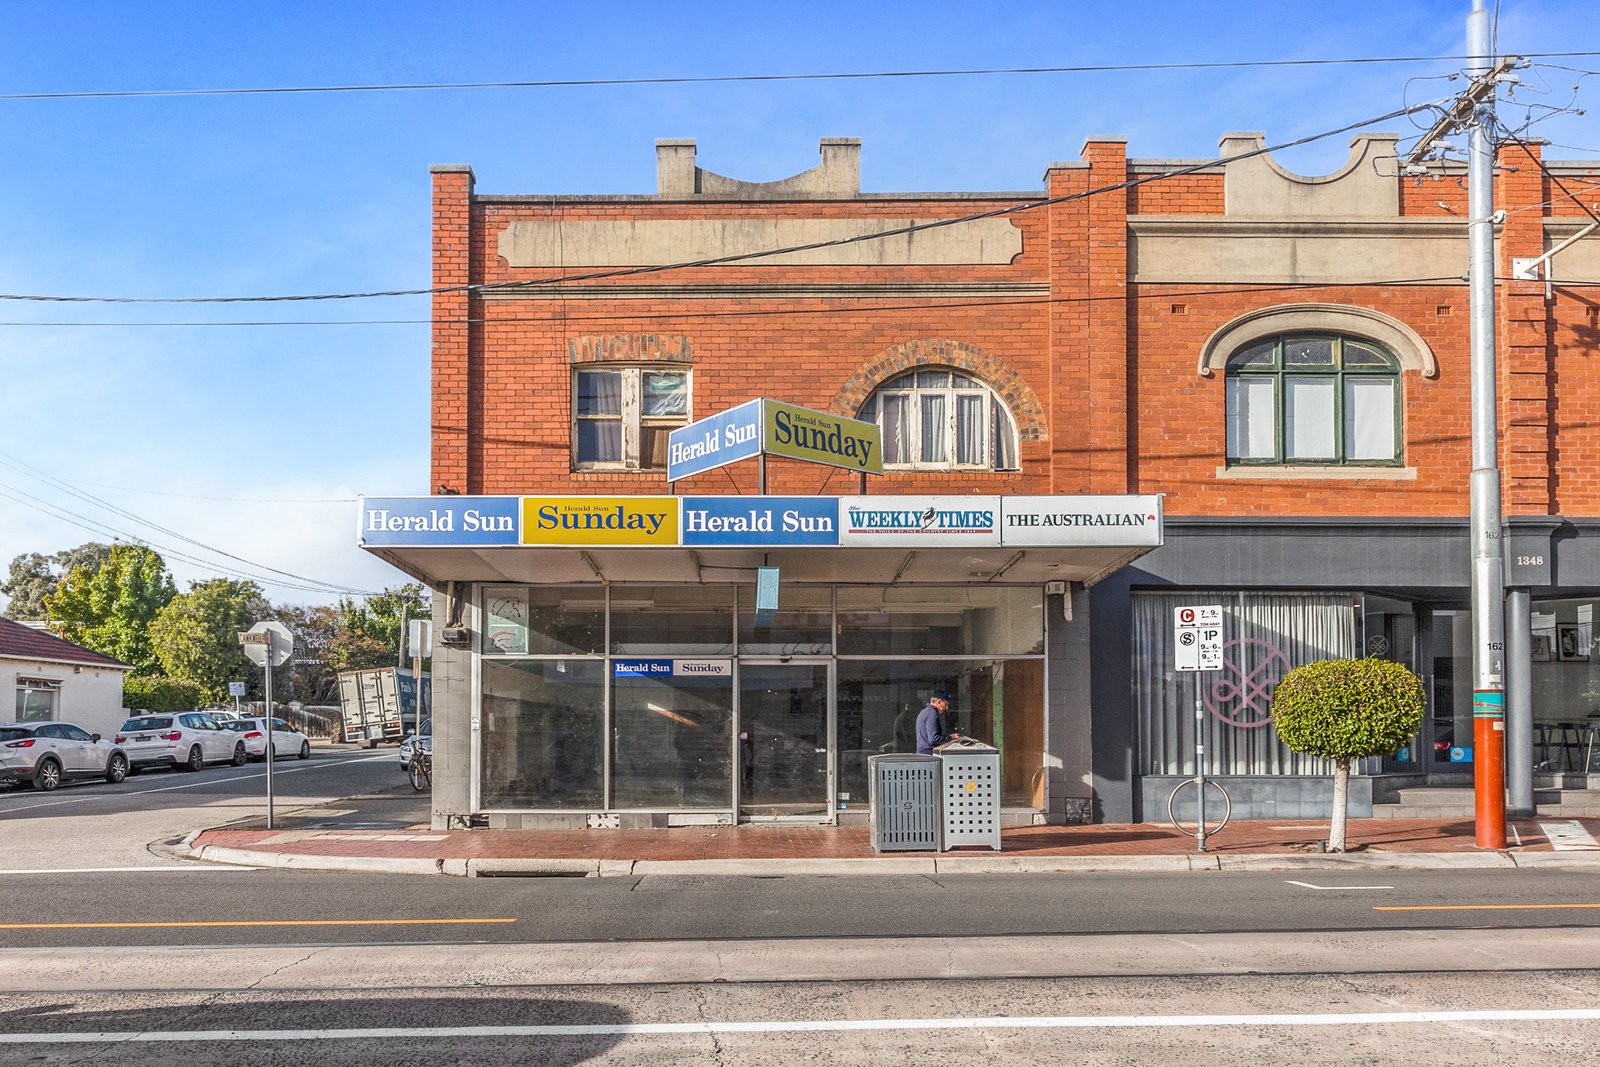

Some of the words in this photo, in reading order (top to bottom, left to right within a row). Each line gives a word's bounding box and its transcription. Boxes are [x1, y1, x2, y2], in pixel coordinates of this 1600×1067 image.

[795, 414, 816, 426] Herald
[818, 418, 831, 429] Sun
[671, 429, 720, 466] Herald
[725, 423, 757, 448] Sun
[775, 410, 873, 467] Sunday
[366, 510, 454, 531] Herald
[463, 510, 514, 531] Sun
[538, 506, 667, 535] Sunday
[686, 510, 774, 532] Herald
[782, 510, 834, 532] Sun
[848, 511, 924, 528] WEEKLY
[936, 510, 993, 528] TIMES
[1007, 514, 1039, 526] THE
[1042, 514, 1145, 526] AUSTRALIAN
[1484, 531, 1500, 539] 162
[1517, 556, 1544, 566] 1348
[1204, 630, 1218, 641] 1P
[1487, 642, 1503, 651] 162
[615, 663, 649, 672] Herald
[651, 663, 670, 672] Sun
[682, 663, 724, 673] Sunday
